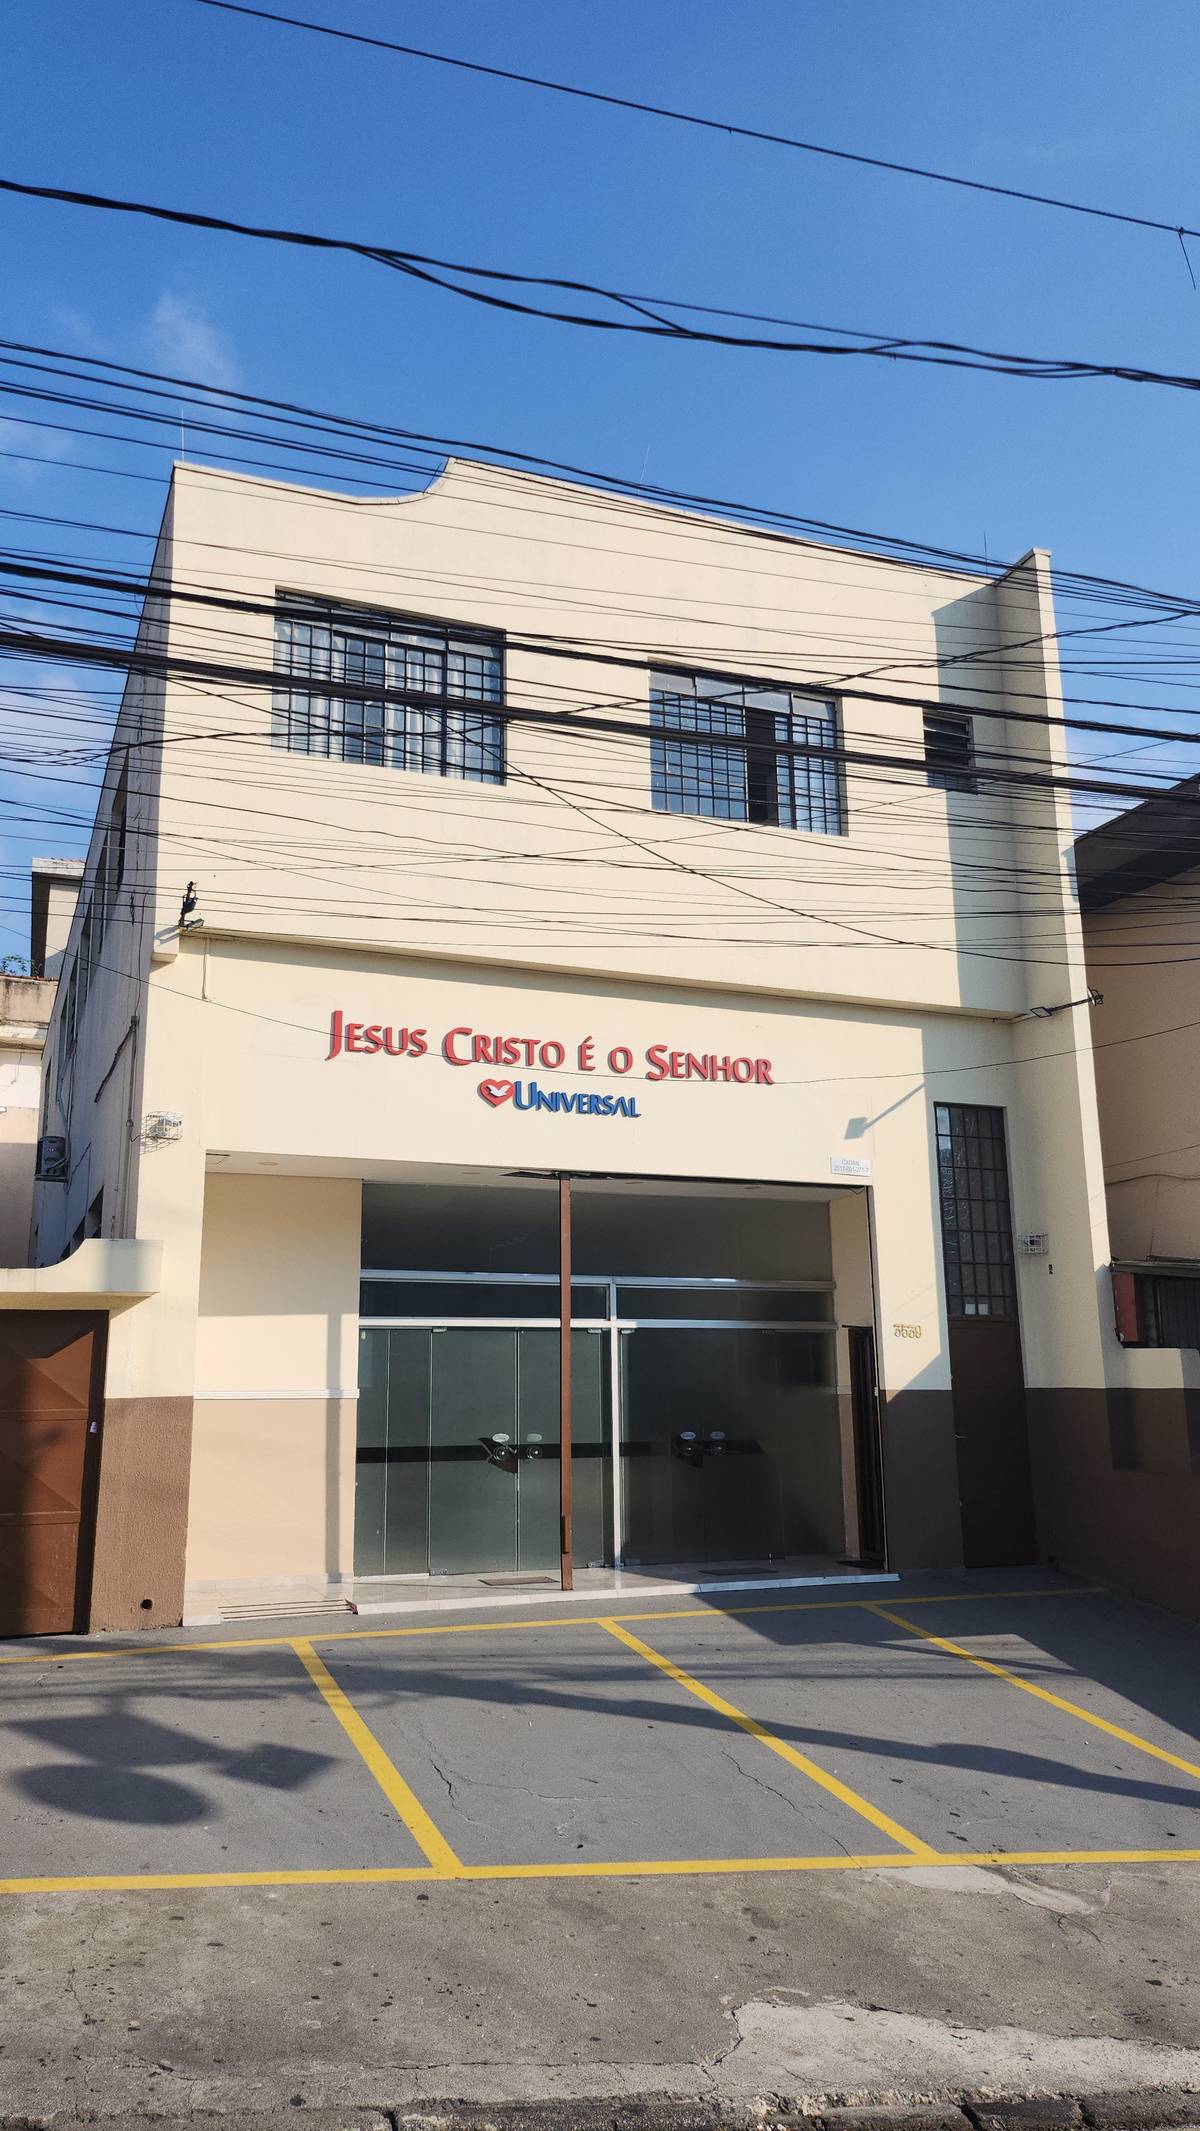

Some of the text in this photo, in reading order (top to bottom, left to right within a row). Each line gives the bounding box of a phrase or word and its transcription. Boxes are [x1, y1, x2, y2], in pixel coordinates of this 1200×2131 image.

[326, 1010, 774, 1085] JESUS CRISTO É O SENHOR
[513, 1080, 641, 1118] UNIVERSAL
